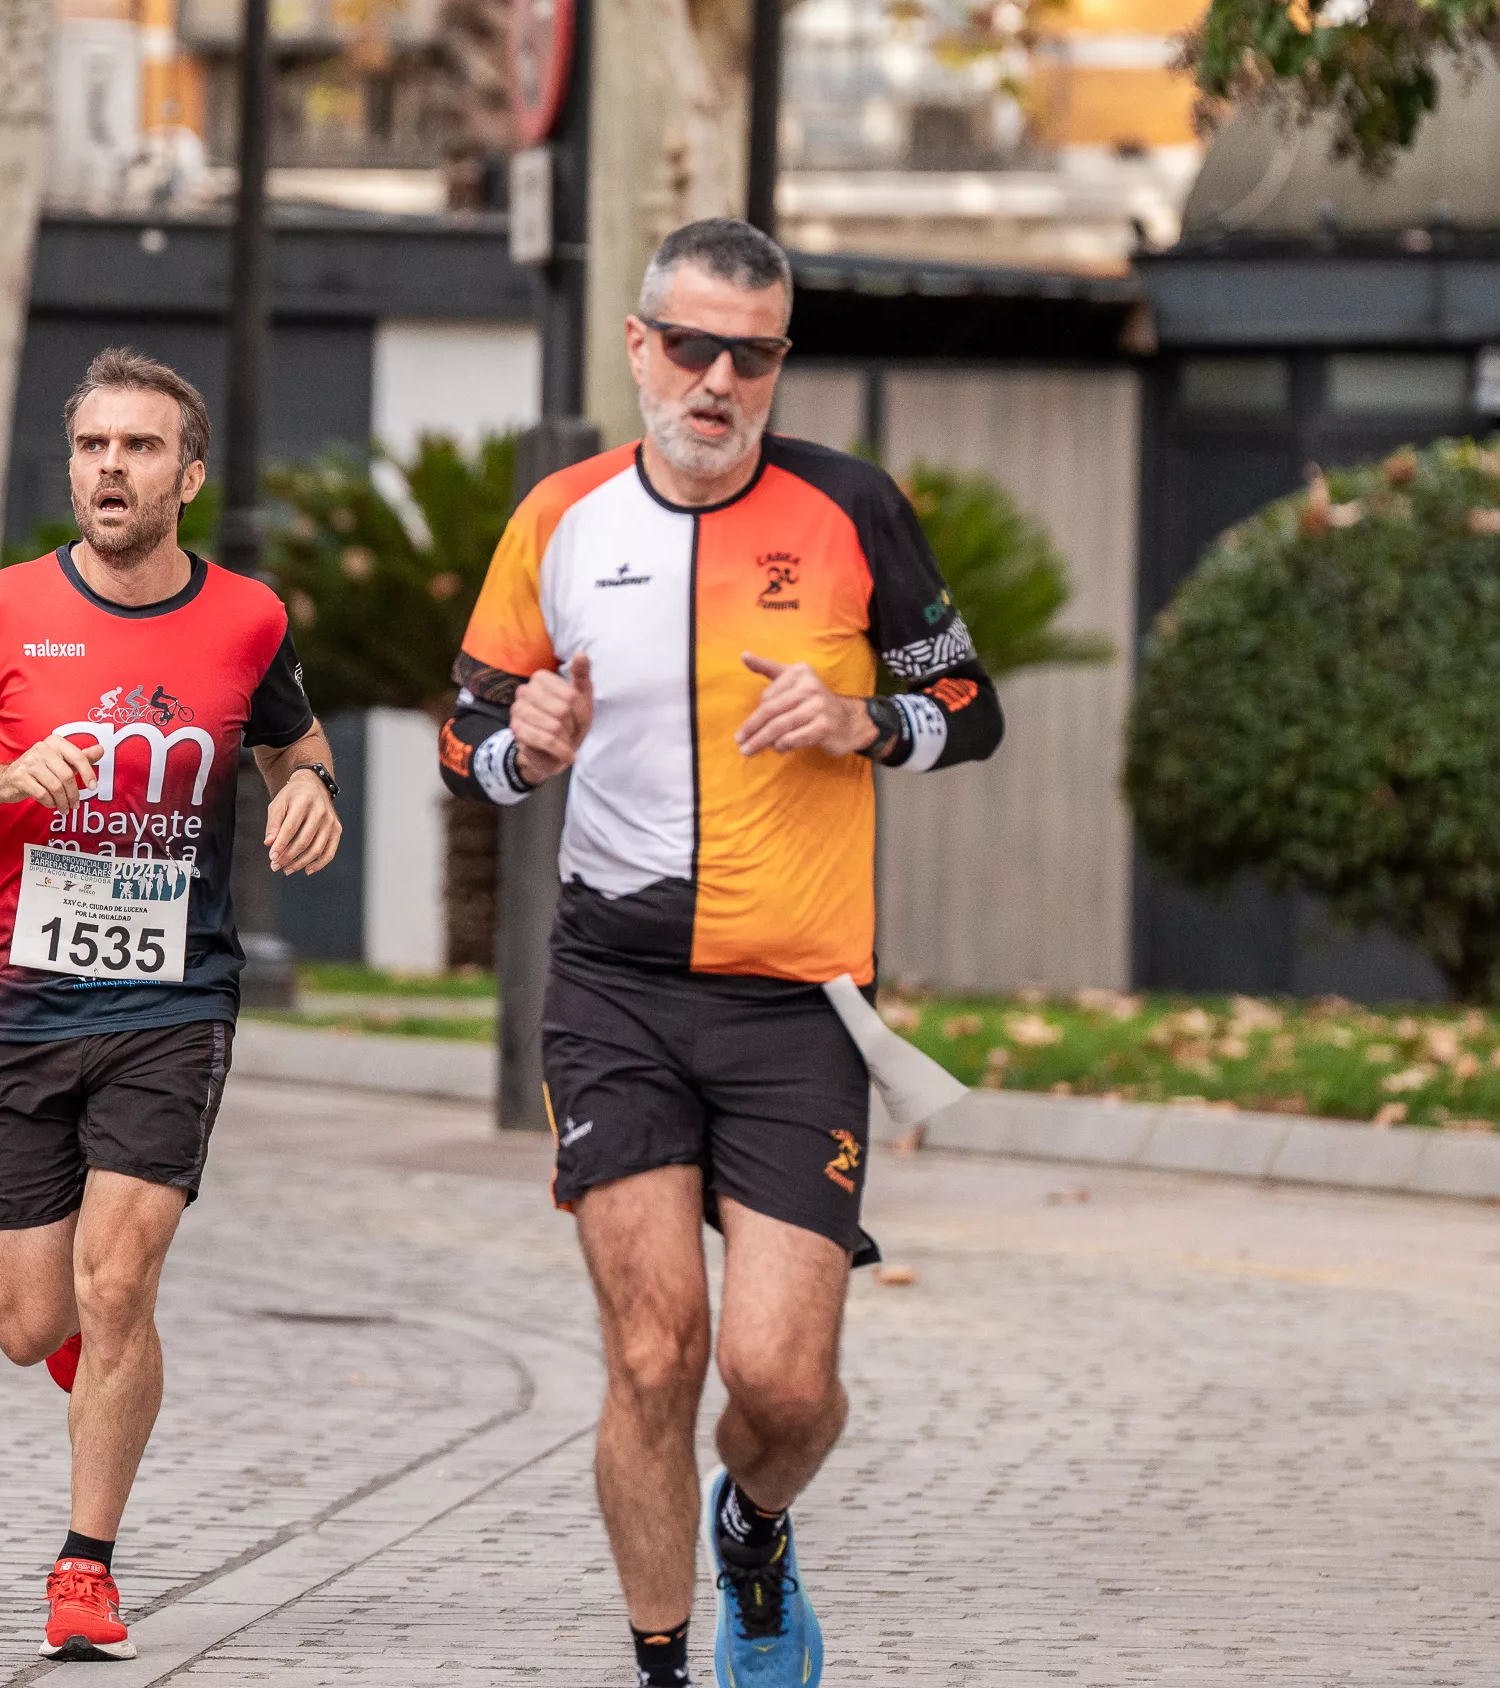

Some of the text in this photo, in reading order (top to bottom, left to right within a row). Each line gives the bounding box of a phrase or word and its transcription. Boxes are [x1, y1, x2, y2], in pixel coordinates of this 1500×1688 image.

[37, 639, 85, 657] alexen
[50, 801, 202, 842] albayate
[30, 849, 112, 871] CIRCUITO PROVINCIAL DE
[30, 856, 112, 878] CARRERAS POPULARES
[69, 872, 77, 880] DE
[114, 863, 155, 880] 2024
[63, 898, 76, 906] XXV
[89, 903, 113, 912] CIUDAD
[123, 906, 148, 914] LUCENA
[75, 909, 87, 918] POR
[98, 913, 132, 922] IGUALDAD
[41, 916, 165, 973] 1535
